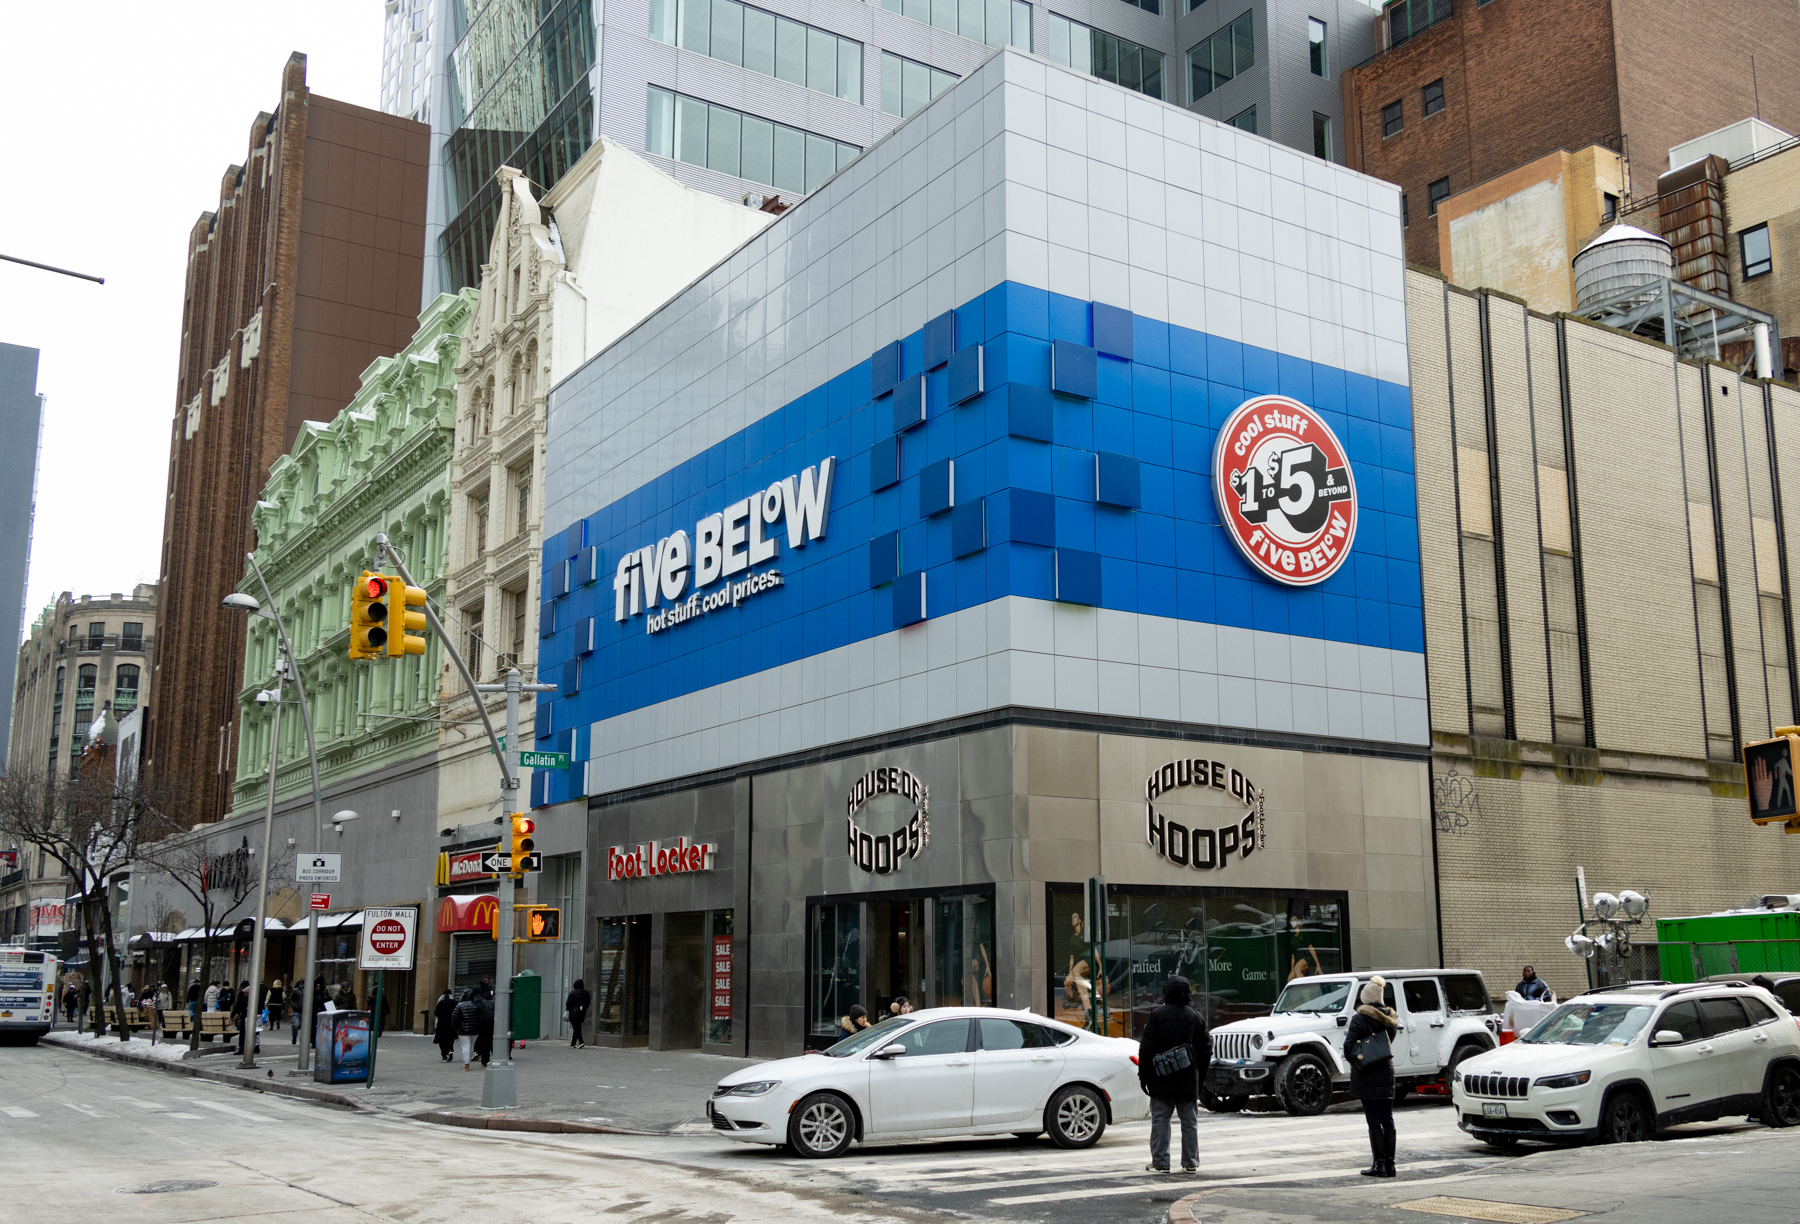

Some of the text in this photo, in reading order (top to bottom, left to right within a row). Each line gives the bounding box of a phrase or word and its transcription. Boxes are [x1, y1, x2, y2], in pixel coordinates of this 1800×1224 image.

[1234, 409, 1309, 456] cool stuff
[1326, 474, 1334, 486] &
[1262, 487, 1275, 499] TO
[1318, 485, 1348, 498] BEYOND
[613, 455, 837, 623] five BELOW
[1249, 510, 1348, 573] five BELOW
[646, 569, 784, 635] hot stuff. cool prices.
[523, 753, 556, 767] Gallatin
[1145, 758, 1256, 807] HOUSE OF
[847, 767, 922, 818] HOUSE OF
[1258, 796, 1266, 816] Foot
[847, 809, 922, 875] HOOPS
[1145, 801, 1256, 869] HOOPS
[1258, 818, 1267, 850] Locker
[451, 858, 482, 877] McDona
[490, 858, 508, 867] ONE
[608, 836, 715, 880] Foot Locker
[715, 944, 730, 956] SALE
[715, 961, 730, 973] SALE
[1132, 958, 1161, 973] rafted
[1208, 958, 1233, 972] More
[1241, 967, 1268, 981] Game
[715, 978, 730, 990] SALE
[714, 995, 730, 1007] SALE
